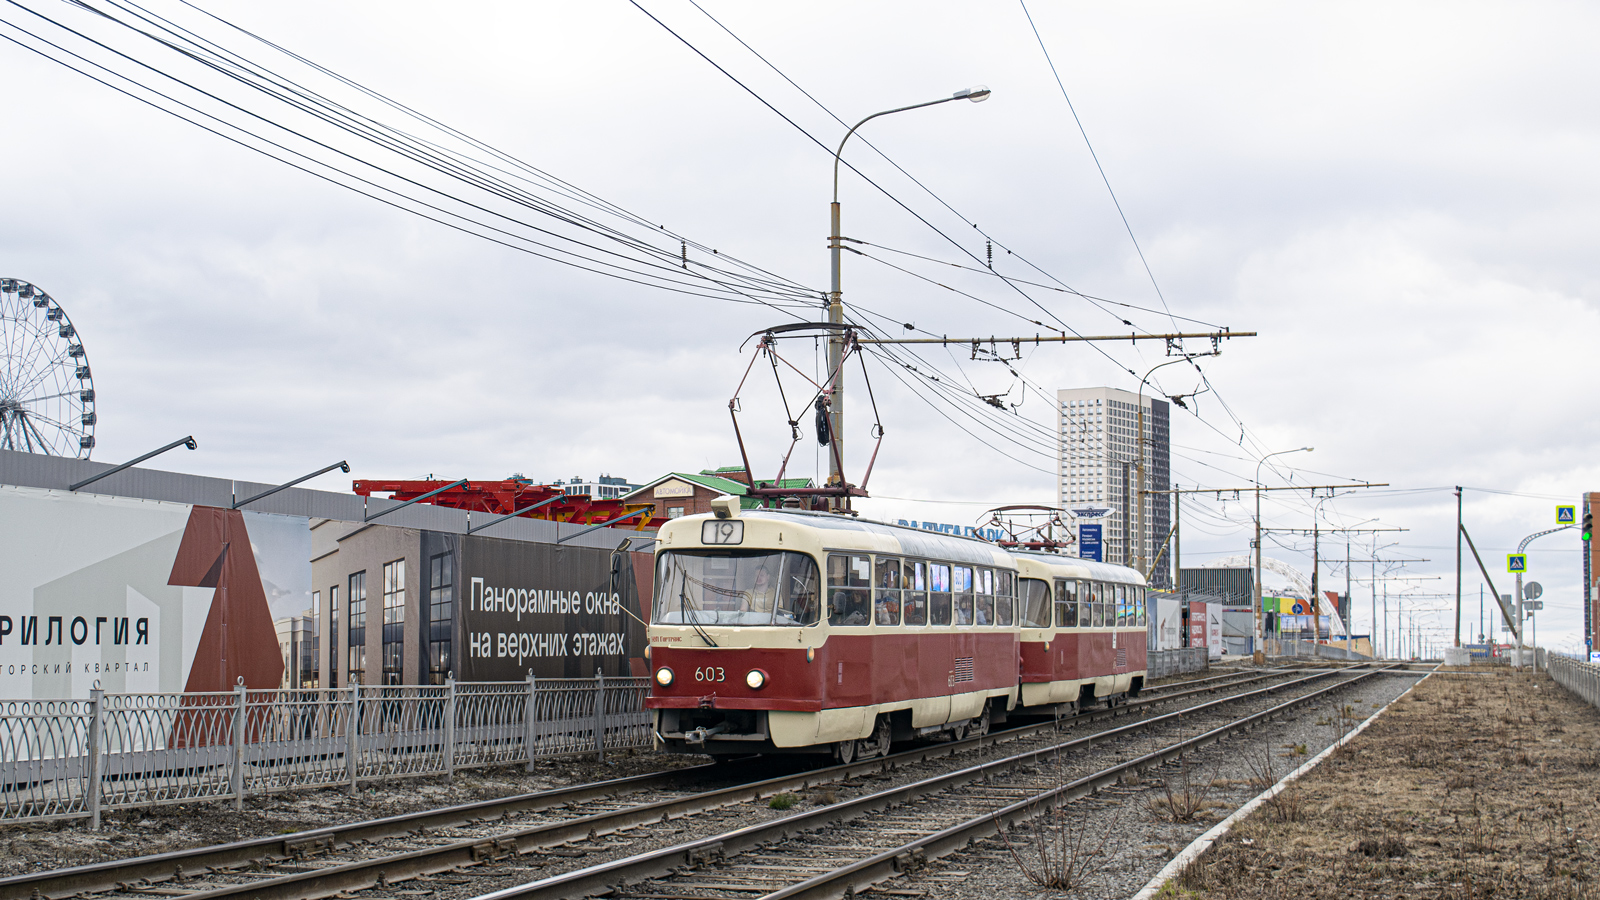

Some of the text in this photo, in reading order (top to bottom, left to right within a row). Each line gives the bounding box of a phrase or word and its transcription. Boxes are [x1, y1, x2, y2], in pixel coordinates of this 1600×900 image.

[655, 486, 692, 495] АВТОМОЙКА
[714, 522, 734, 543] 19
[470, 576, 620, 621] Панорамные окна
[0, 616, 149, 645] РИЛОГИЯ
[470, 632, 625, 666] на верхних этажах
[85, 662, 148, 673] КВАРТАЛ
[695, 666, 725, 682] 603
